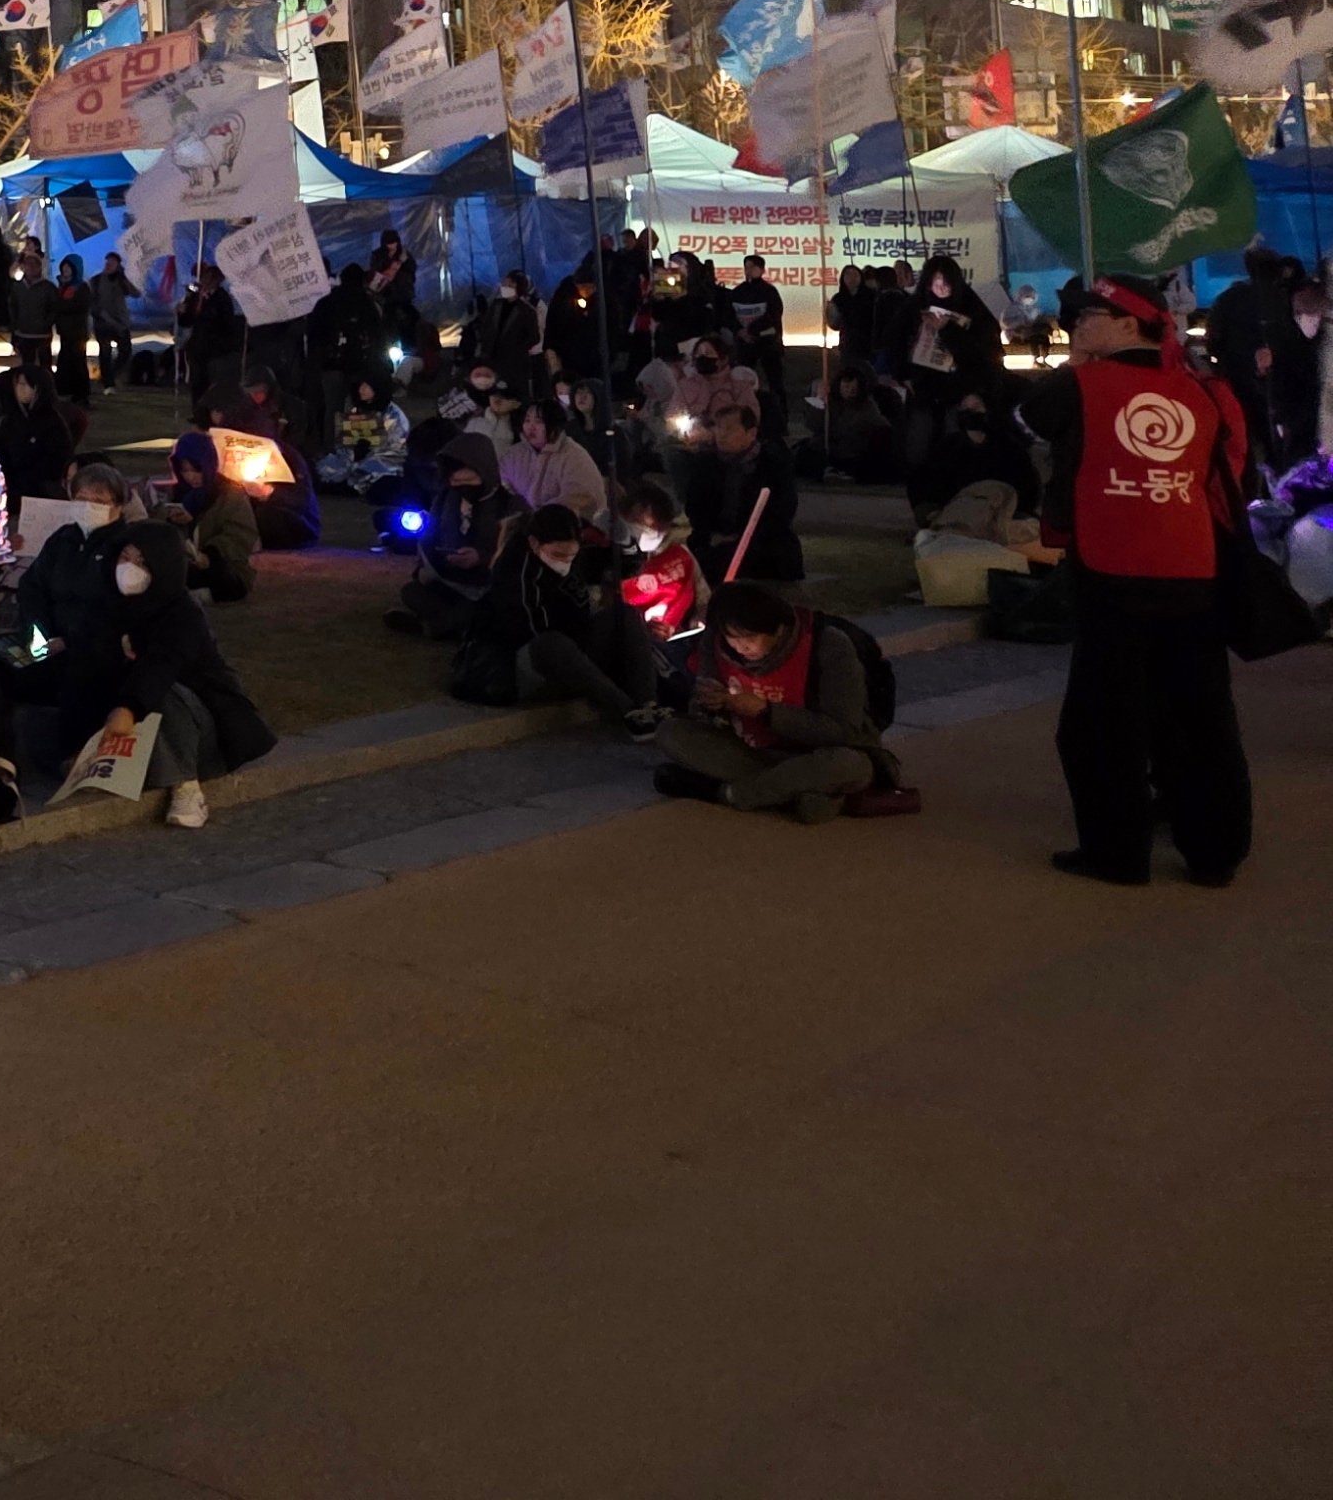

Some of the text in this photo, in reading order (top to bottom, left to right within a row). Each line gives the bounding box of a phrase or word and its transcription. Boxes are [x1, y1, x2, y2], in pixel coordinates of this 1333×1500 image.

[691, 206, 726, 224] 내란
[728, 206, 760, 224] 위한
[838, 207, 882, 228] 윤석열
[883, 208, 915, 229] 즉각
[1103, 467, 1195, 504] 노동당
